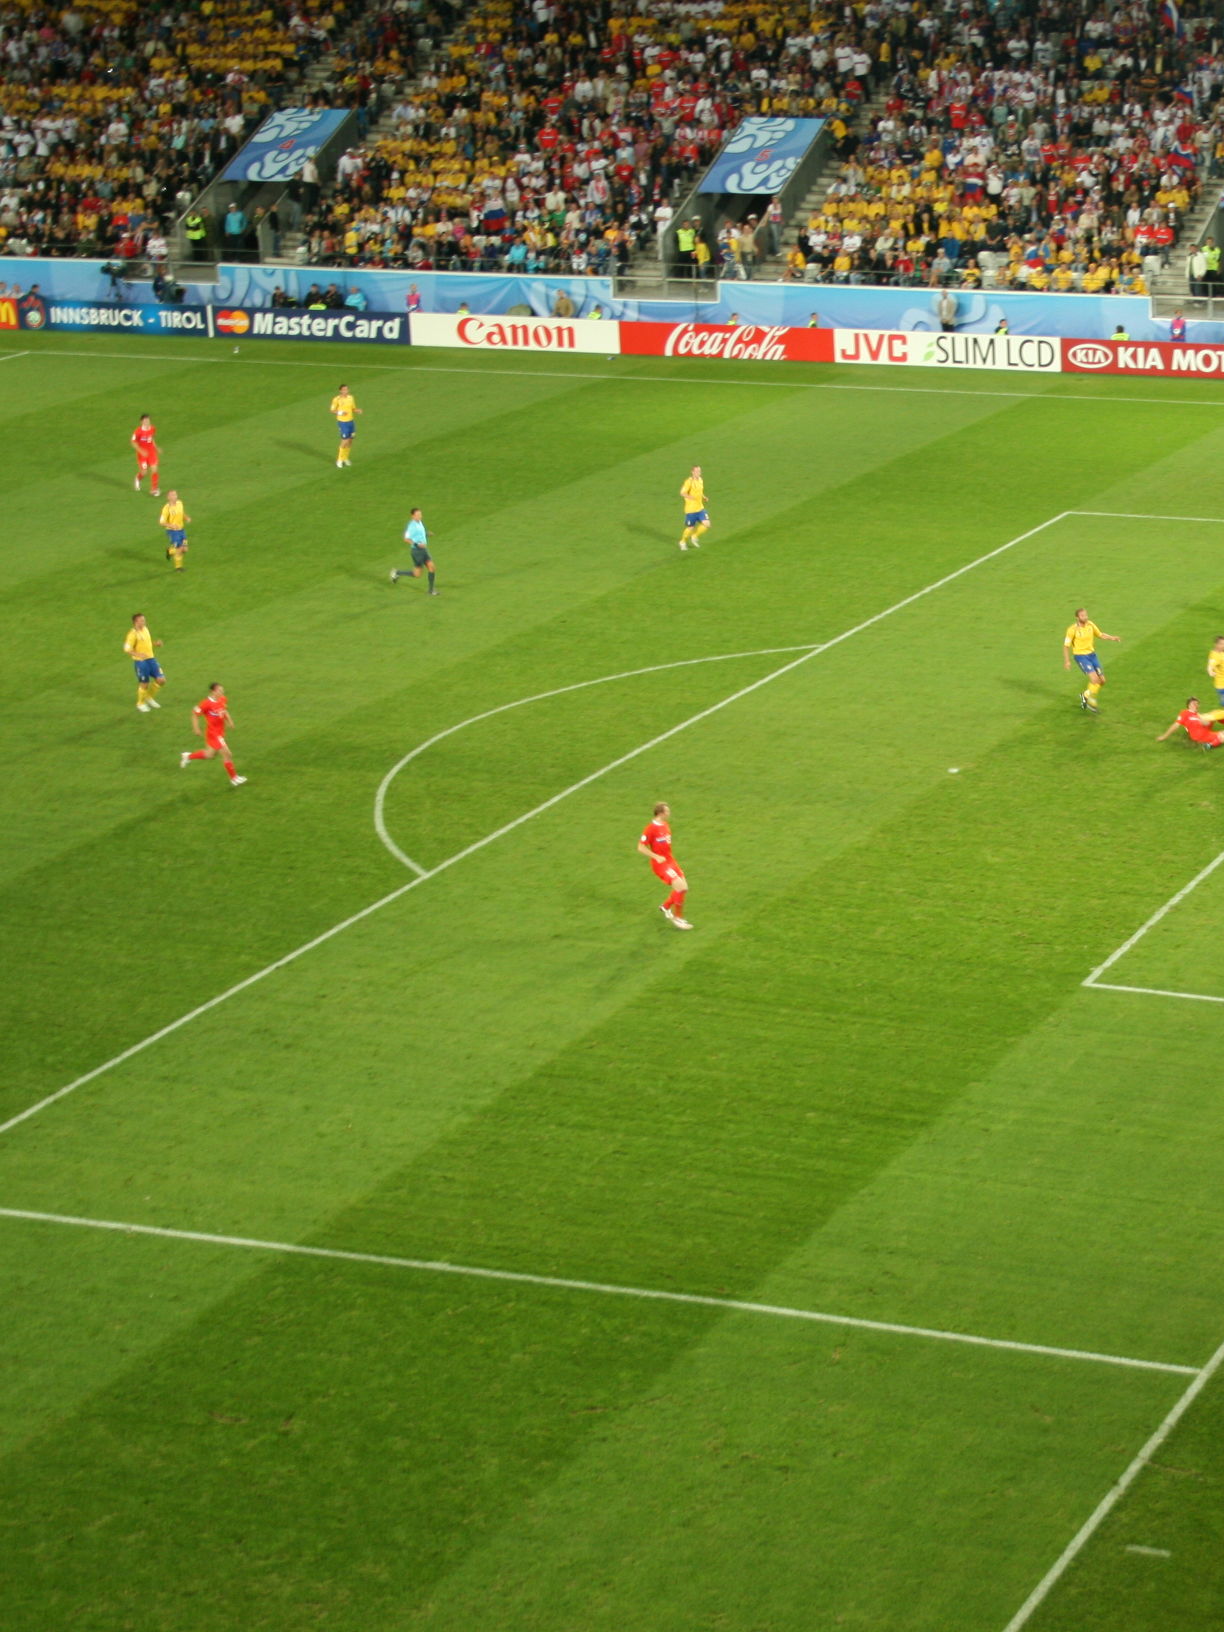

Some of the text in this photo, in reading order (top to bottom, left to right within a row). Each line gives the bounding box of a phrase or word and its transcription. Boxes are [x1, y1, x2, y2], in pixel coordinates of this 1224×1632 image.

[755, 148, 777, 162] 5
[50, 304, 143, 327] INNSBRUCK
[158, 309, 205, 330] TIROL
[252, 312, 401, 340] MasterCard
[456, 317, 576, 349] Canon
[840, 332, 908, 363] JVC
[936, 336, 1056, 368] SLIM LCD
[1117, 346, 1165, 371] KIA
